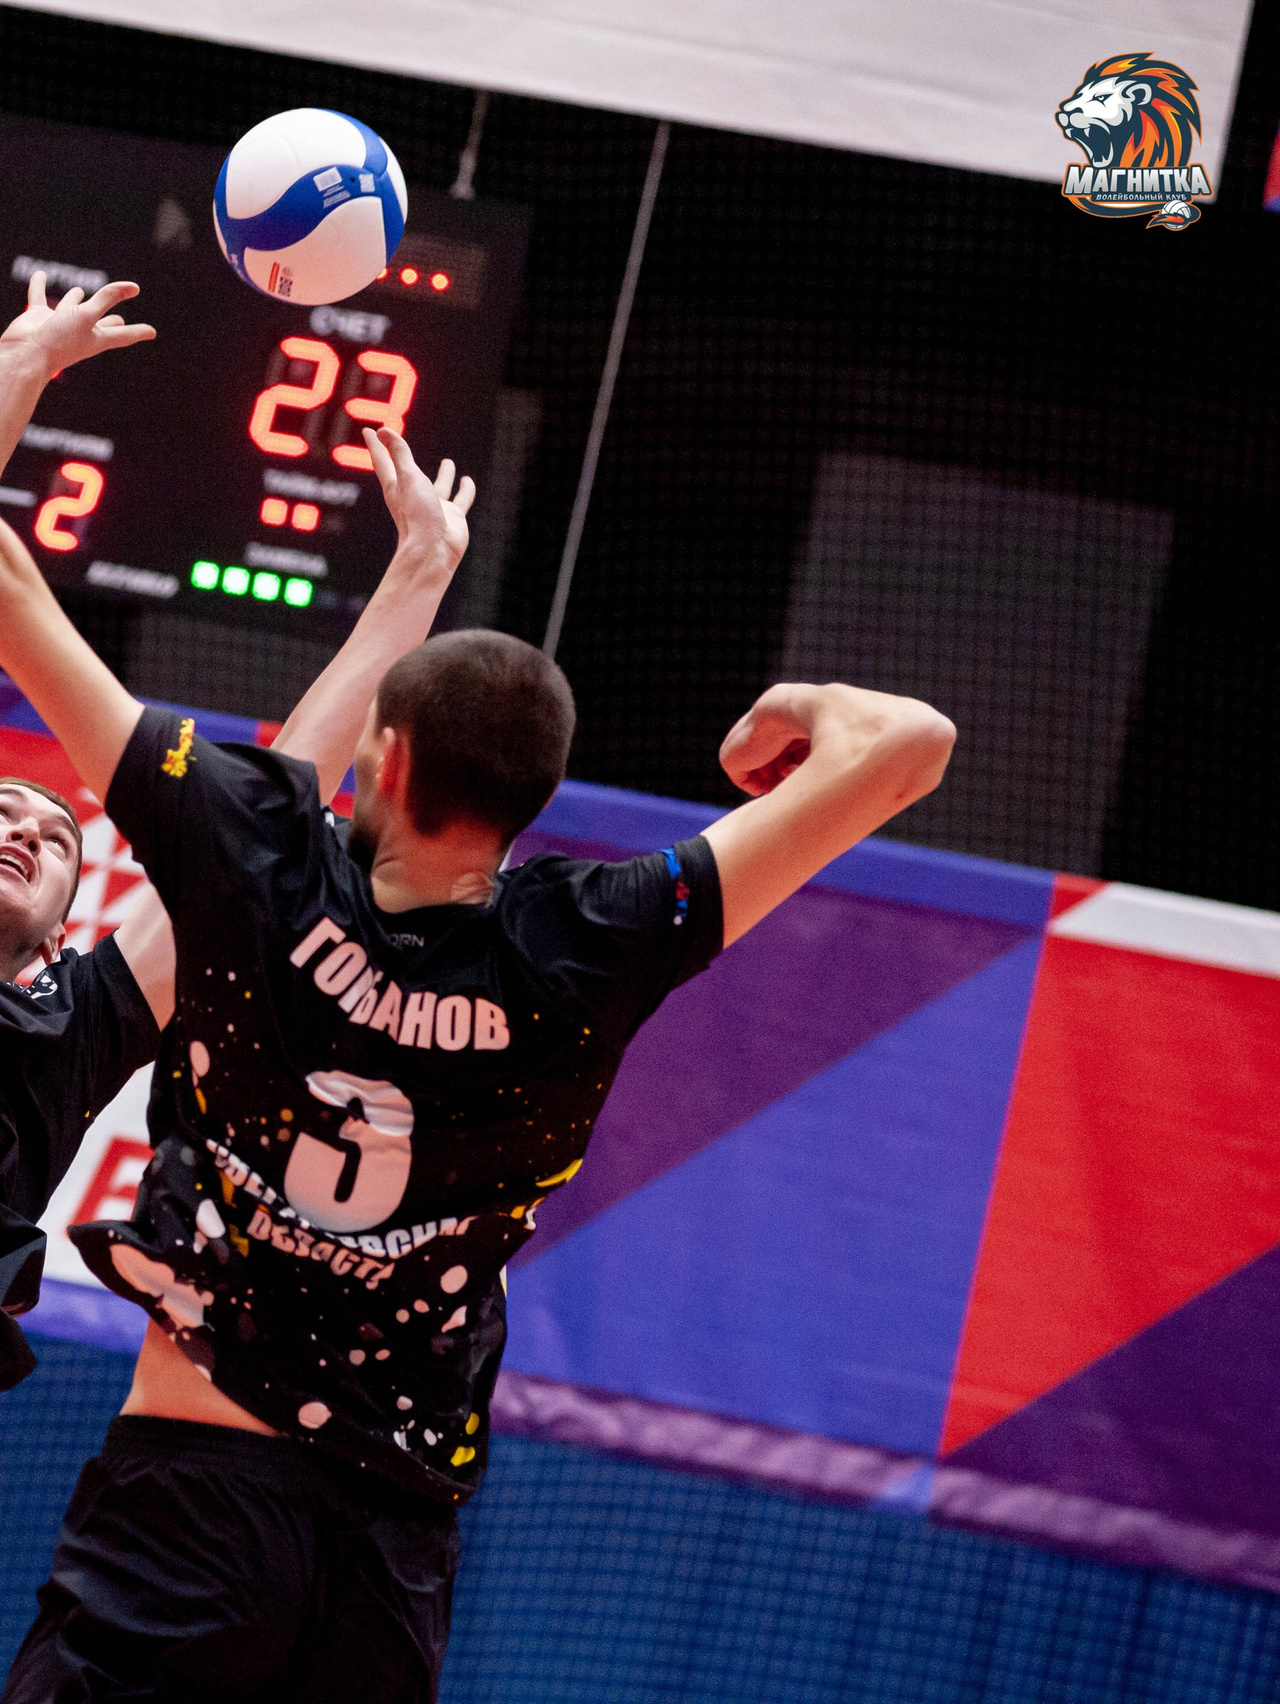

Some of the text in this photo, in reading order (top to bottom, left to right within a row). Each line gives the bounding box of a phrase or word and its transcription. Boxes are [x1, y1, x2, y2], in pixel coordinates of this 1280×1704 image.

[249, 336, 418, 472] 23
[34, 462, 104, 551] 2
[284, 1069, 414, 1232] 3
